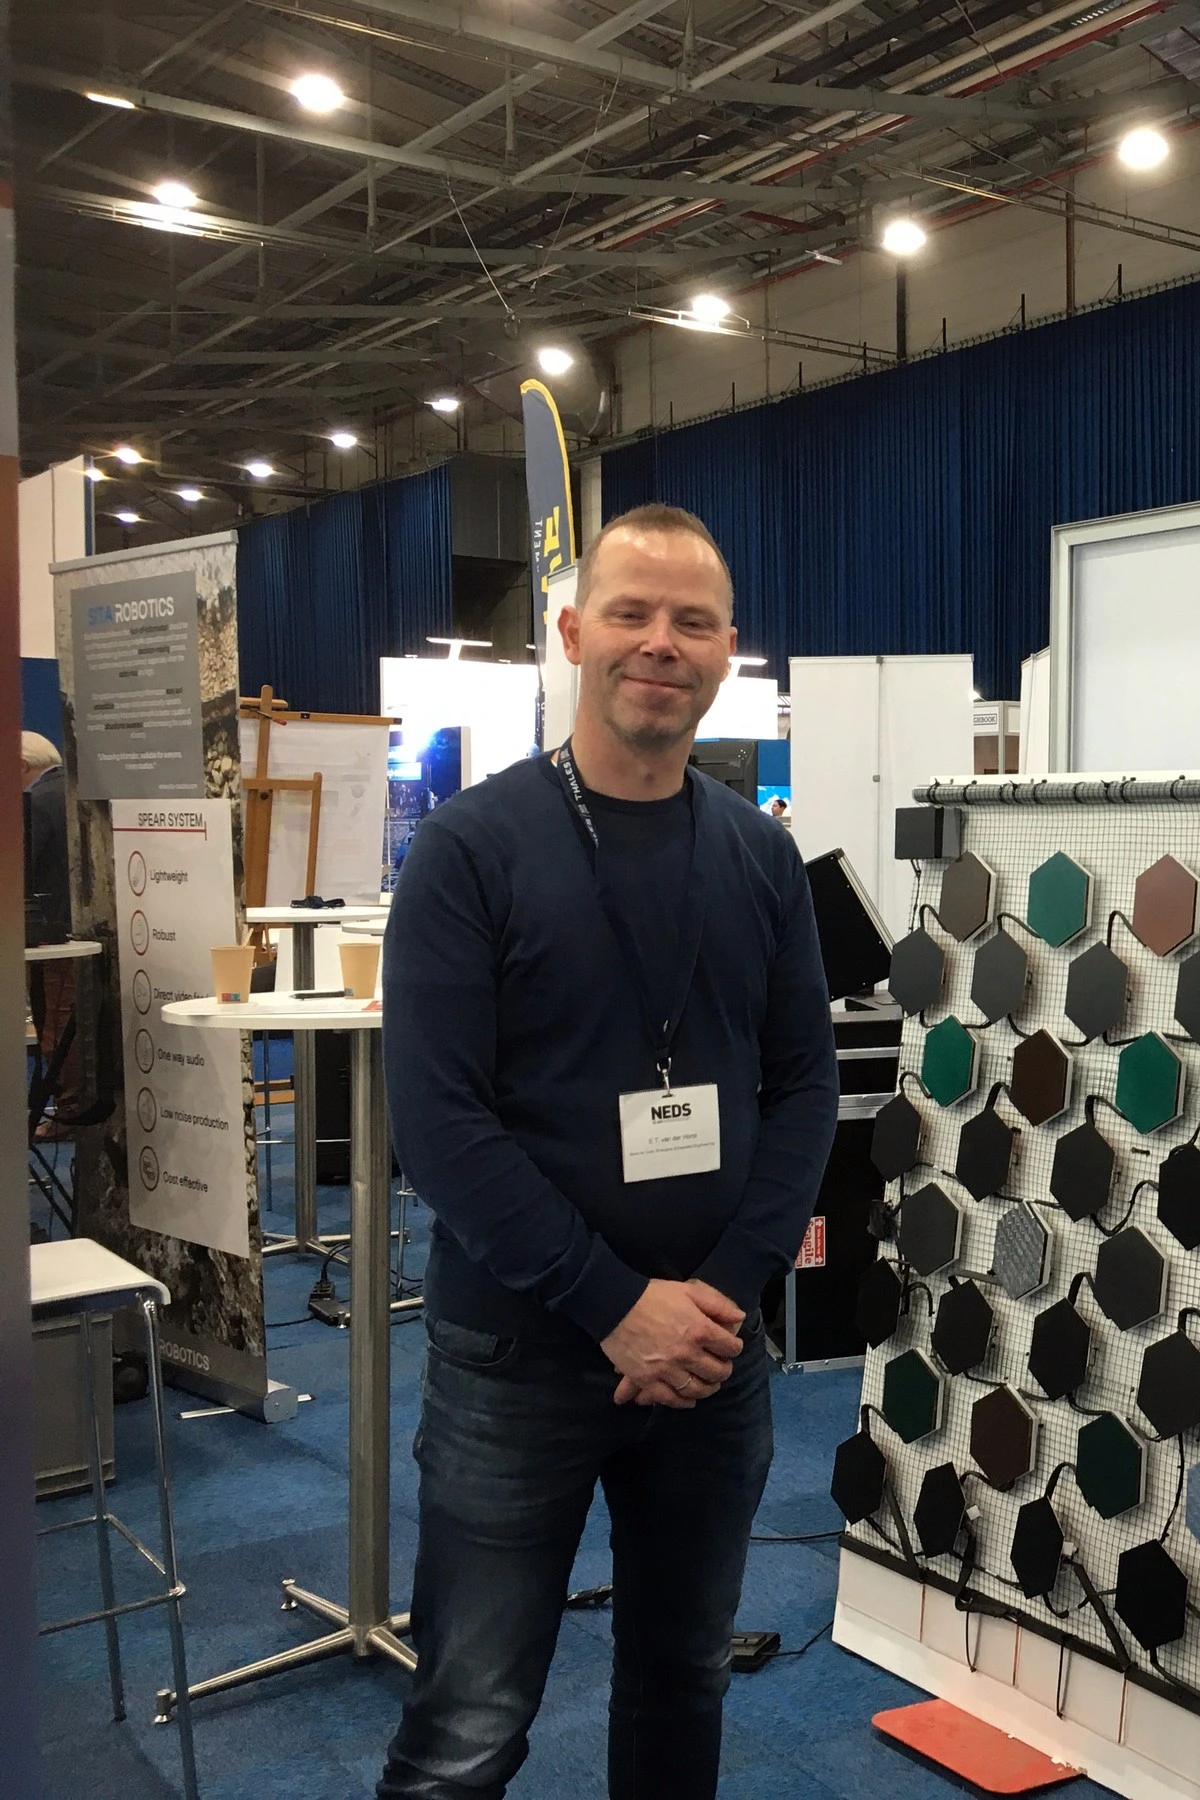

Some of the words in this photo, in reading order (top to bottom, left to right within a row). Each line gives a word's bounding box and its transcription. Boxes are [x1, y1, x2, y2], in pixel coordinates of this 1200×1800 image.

[115, 596, 175, 623] ROBOTICS
[563, 762, 582, 802] THALES
[138, 813, 166, 827] SPEAR
[168, 813, 203, 827] SYSTEM
[149, 869, 188, 885] Lightweight
[152, 928, 177, 941] Robust
[154, 987, 173, 1001] Direct
[157, 1048, 171, 1061] One
[172, 1052, 186, 1066] way
[187, 1054, 205, 1067] audio
[161, 1106, 173, 1119] Low
[193, 1115, 229, 1131] production
[651, 1103, 692, 1120] NEDS
[163, 1171, 178, 1185] Cost
[180, 1176, 208, 1193] effective
[160, 1339, 210, 1371] ROBOTICS
